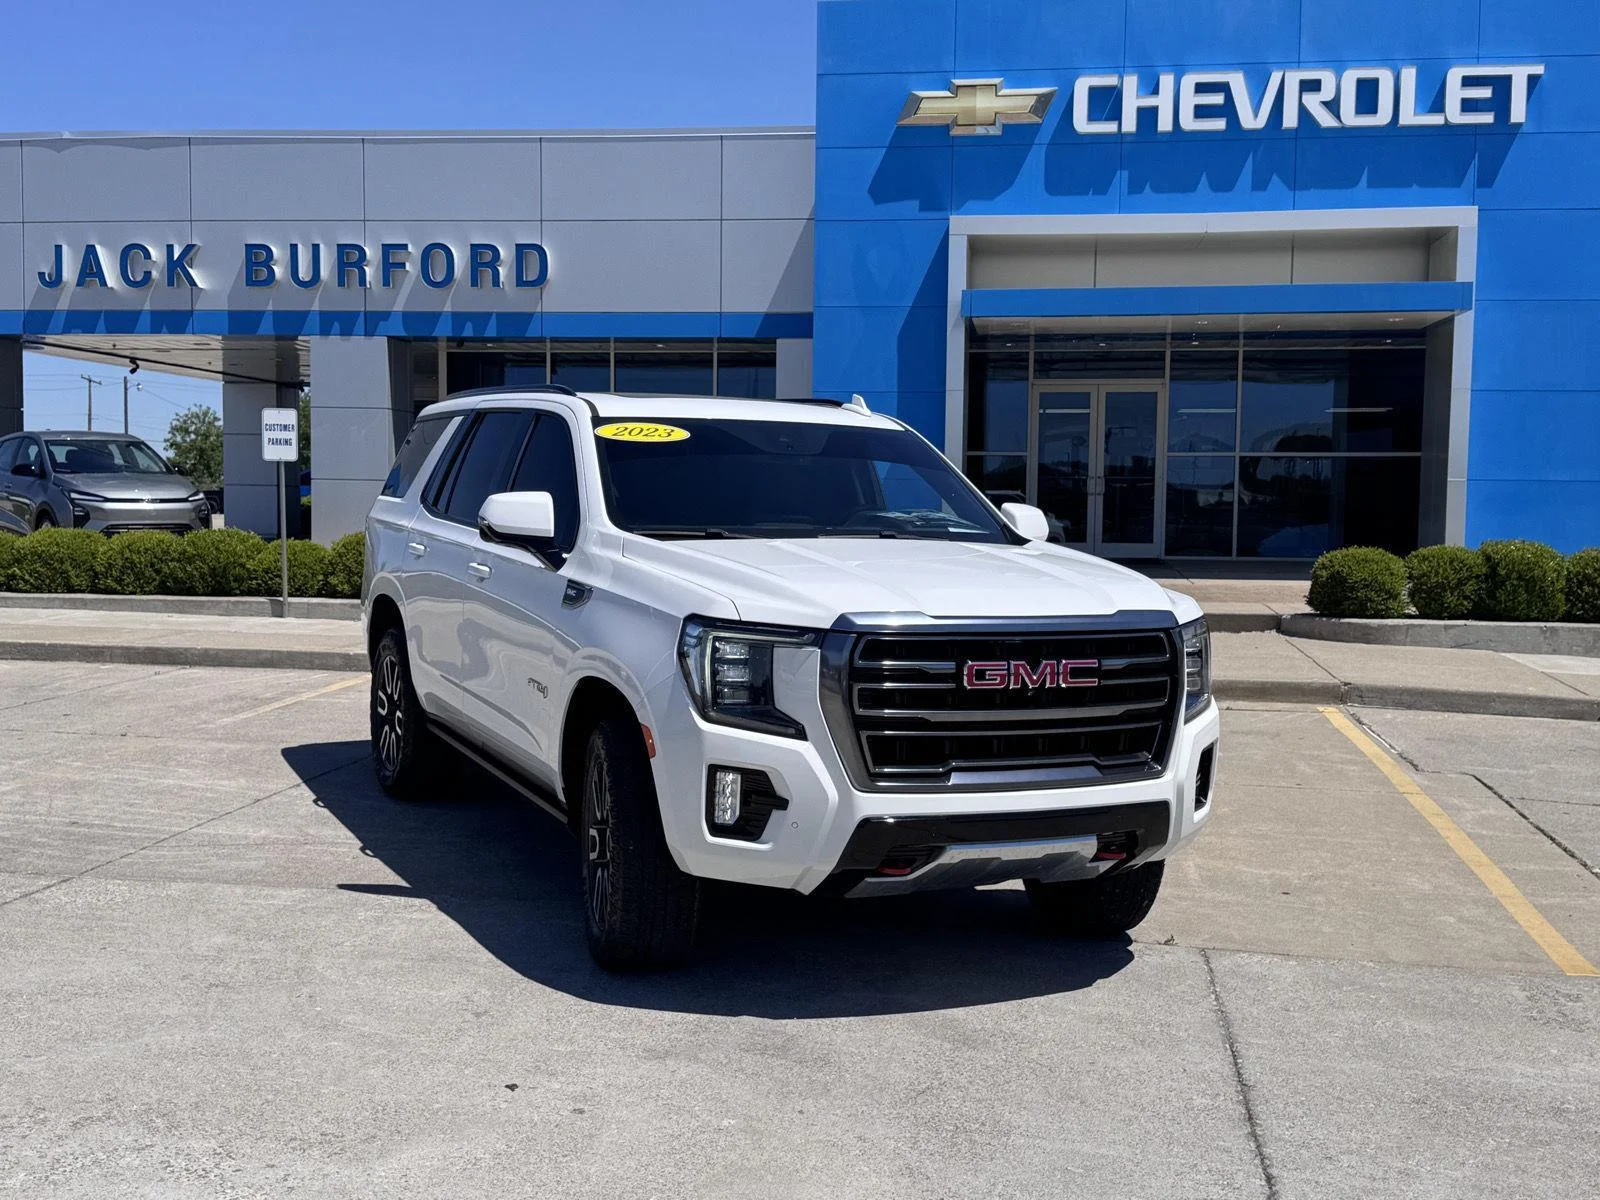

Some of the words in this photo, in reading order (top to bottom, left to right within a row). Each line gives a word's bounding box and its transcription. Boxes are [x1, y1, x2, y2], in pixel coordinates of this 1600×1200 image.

[1072, 65, 1545, 134] CHEVROLET
[37, 242, 200, 289] JACK
[244, 242, 549, 289] BURFORD
[264, 423, 296, 432] CUSTOMER
[611, 426, 675, 438] 2023
[267, 437, 293, 447] PARKING
[963, 659, 1099, 690] GMC
